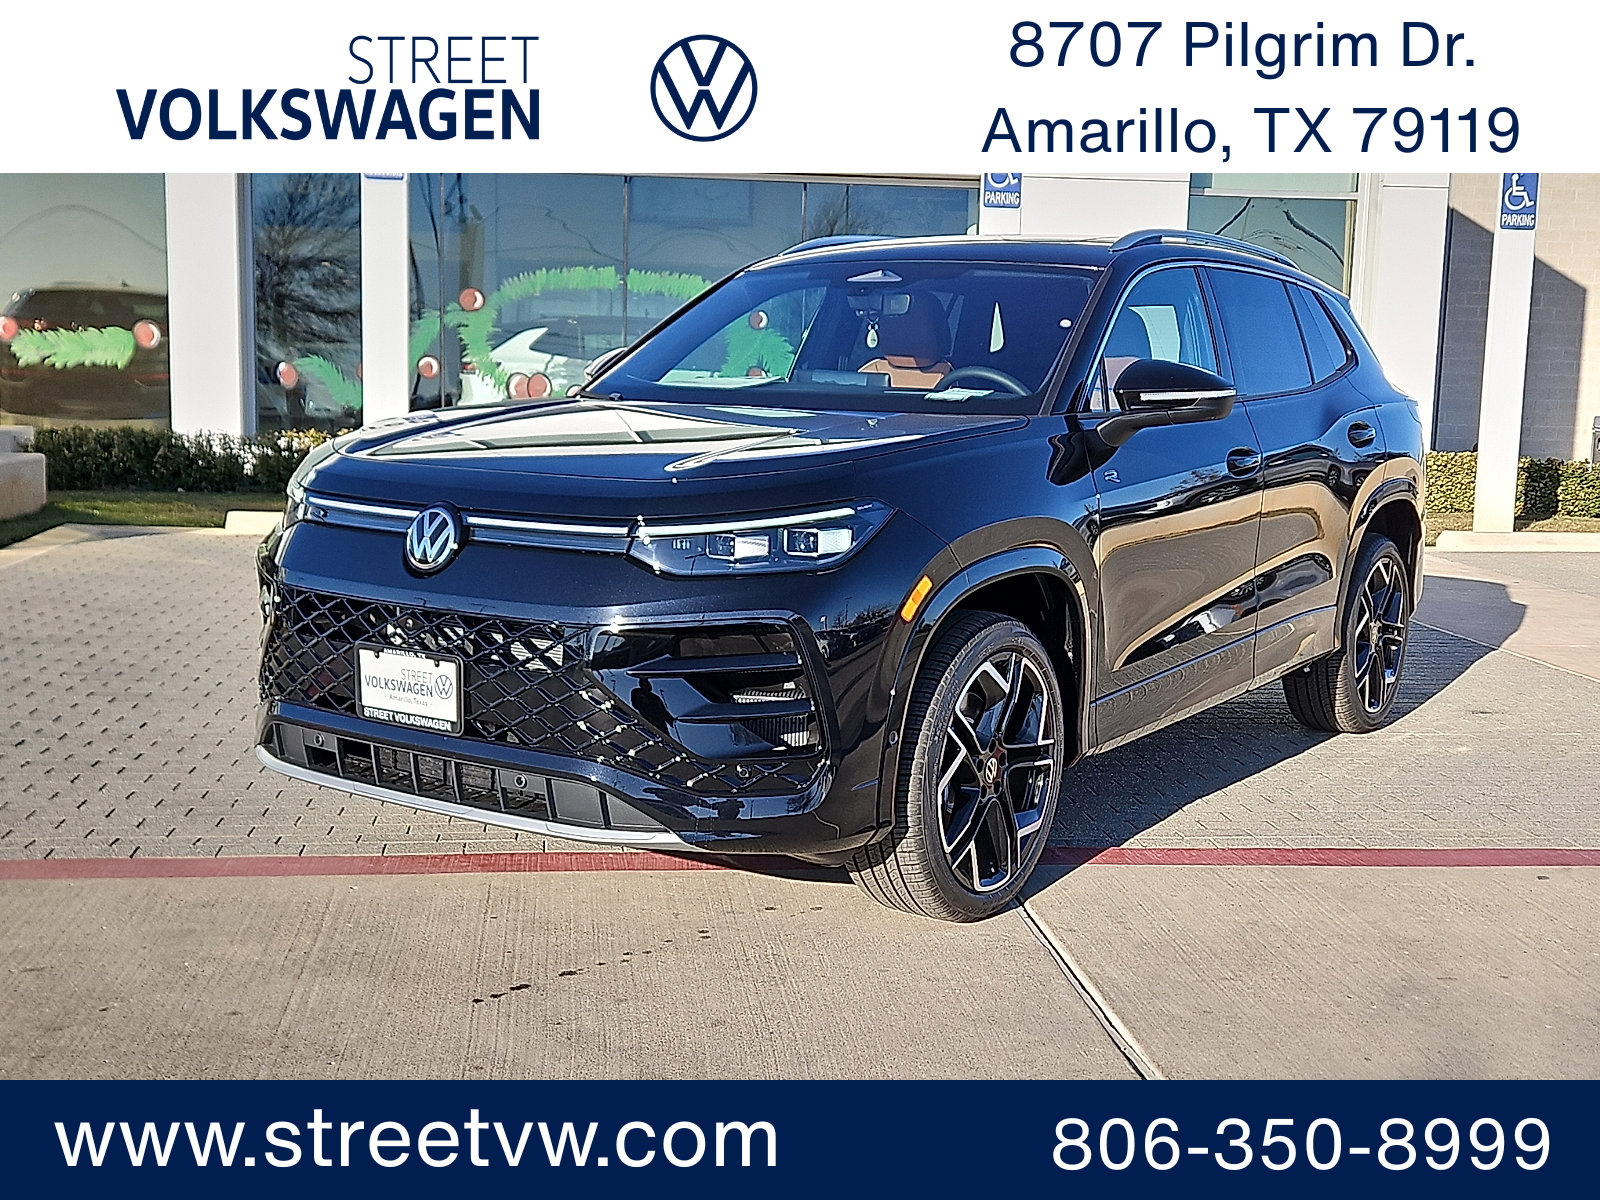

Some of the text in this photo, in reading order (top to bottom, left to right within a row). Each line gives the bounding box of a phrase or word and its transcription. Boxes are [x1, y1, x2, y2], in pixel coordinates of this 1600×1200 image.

[985, 191, 1020, 205] PARKING
[1501, 213, 1535, 226] PARKING
[401, 668, 433, 684] STREET
[364, 674, 433, 698] VOLKSWAGEN
[363, 707, 452, 732] STREET VOLKSWAGEN
